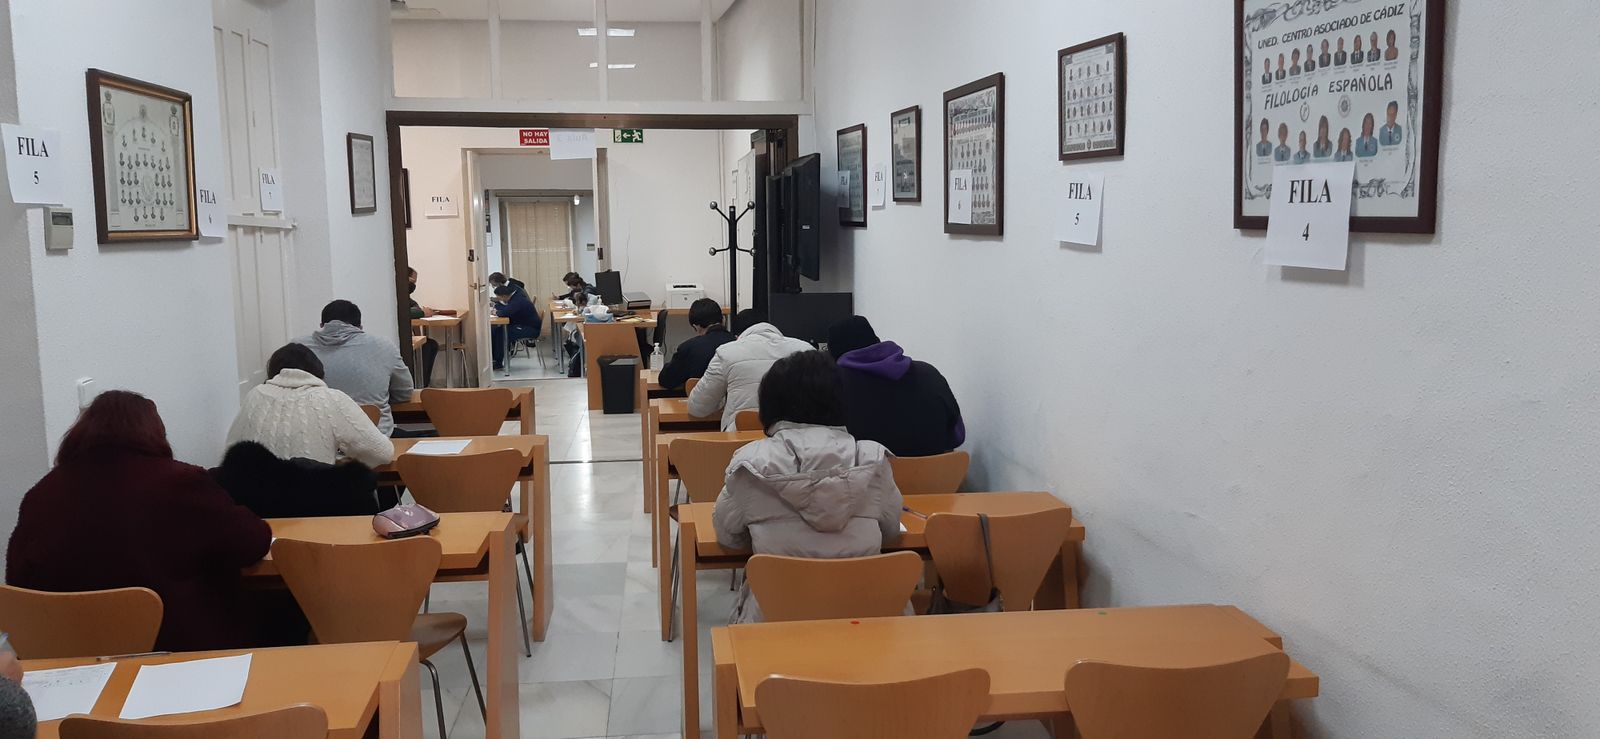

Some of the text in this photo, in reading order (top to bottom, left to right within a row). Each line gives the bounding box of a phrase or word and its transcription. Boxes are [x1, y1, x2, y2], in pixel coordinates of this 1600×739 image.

[1281, 27, 1313, 43] CENTRO
[1313, 15, 1359, 36] ASOCIADO
[1360, 11, 1372, 25] DE
[1328, 72, 1393, 94] ESPAÑOLA
[17, 136, 49, 158] FILA
[33, 170, 40, 185] 5
[261, 173, 276, 185] FILA
[954, 177, 968, 191] FILA
[200, 189, 217, 205] FILA
[1068, 182, 1092, 201] FILA
[1288, 178, 1332, 204] FILA
[1074, 212, 1080, 226] 5
[1302, 222, 1310, 242] 4
